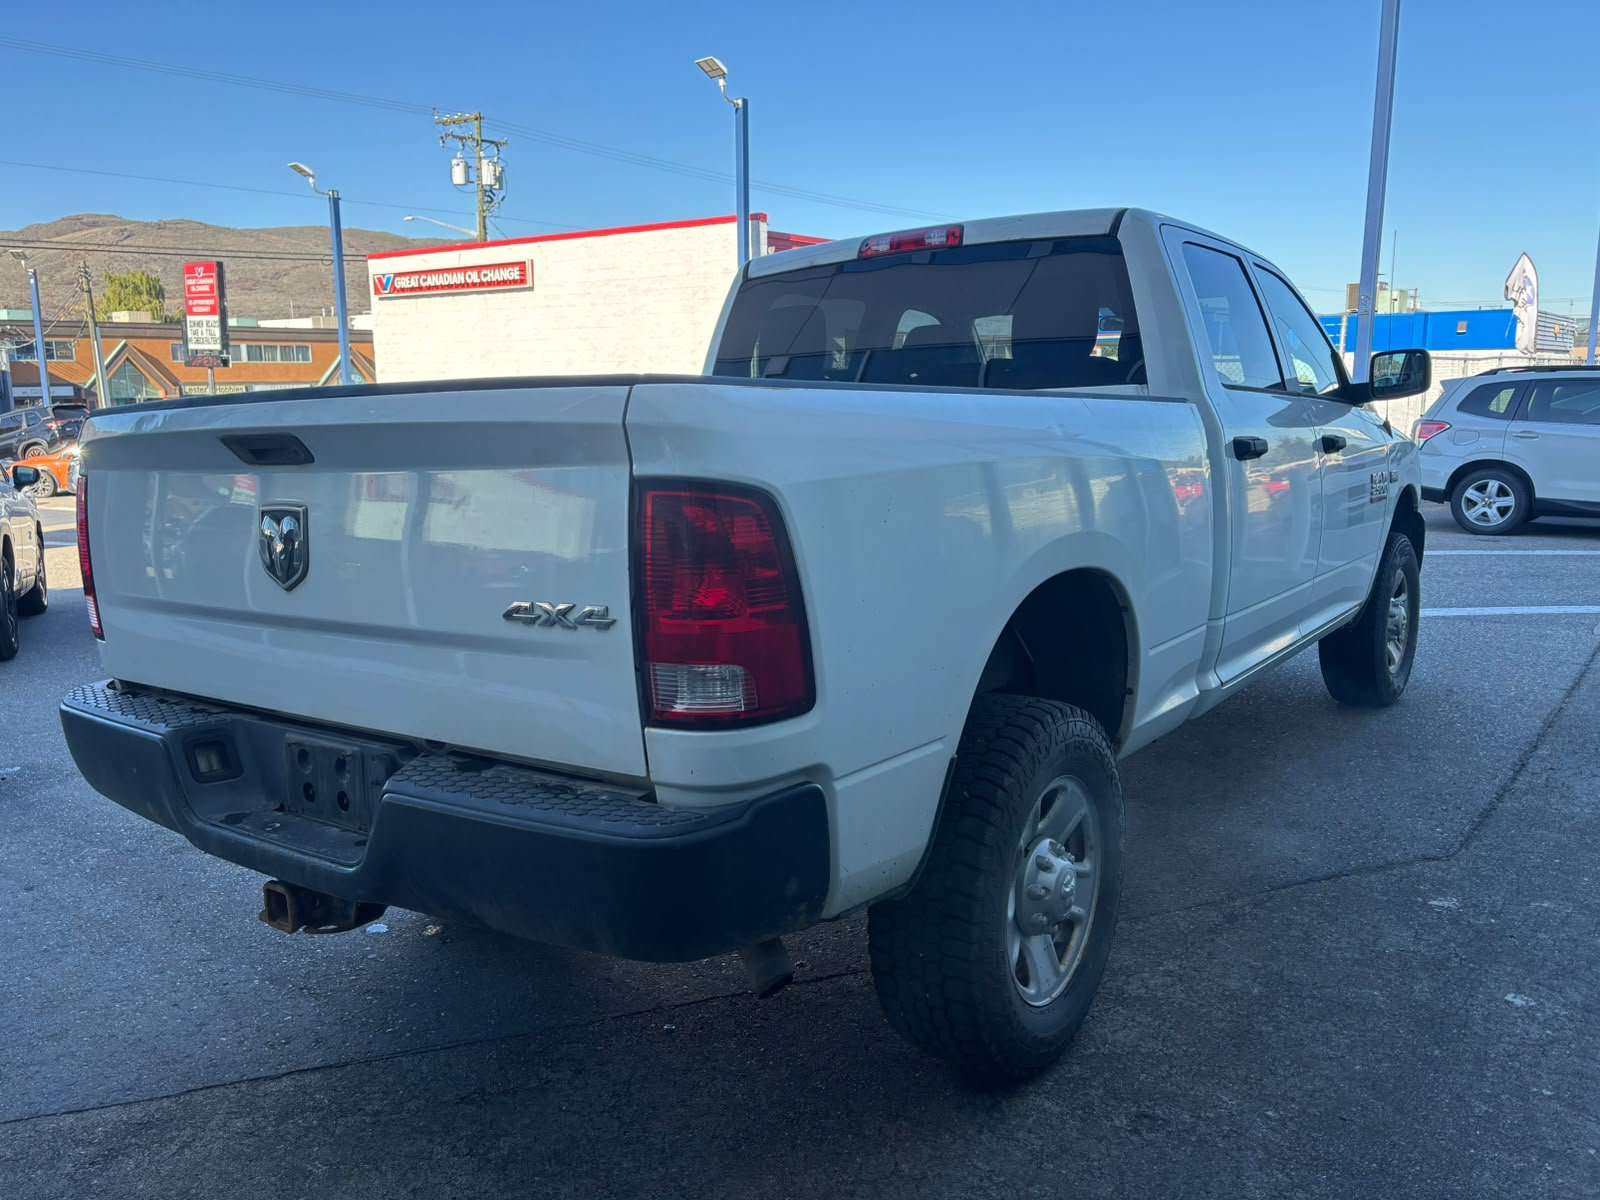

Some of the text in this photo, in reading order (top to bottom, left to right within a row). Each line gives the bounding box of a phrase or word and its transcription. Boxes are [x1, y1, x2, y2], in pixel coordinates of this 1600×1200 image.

[394, 275, 419, 289] GREAT
[420, 271, 464, 287] CANADIAN
[465, 270, 480, 283] OIL
[481, 267, 520, 282] CHANGE
